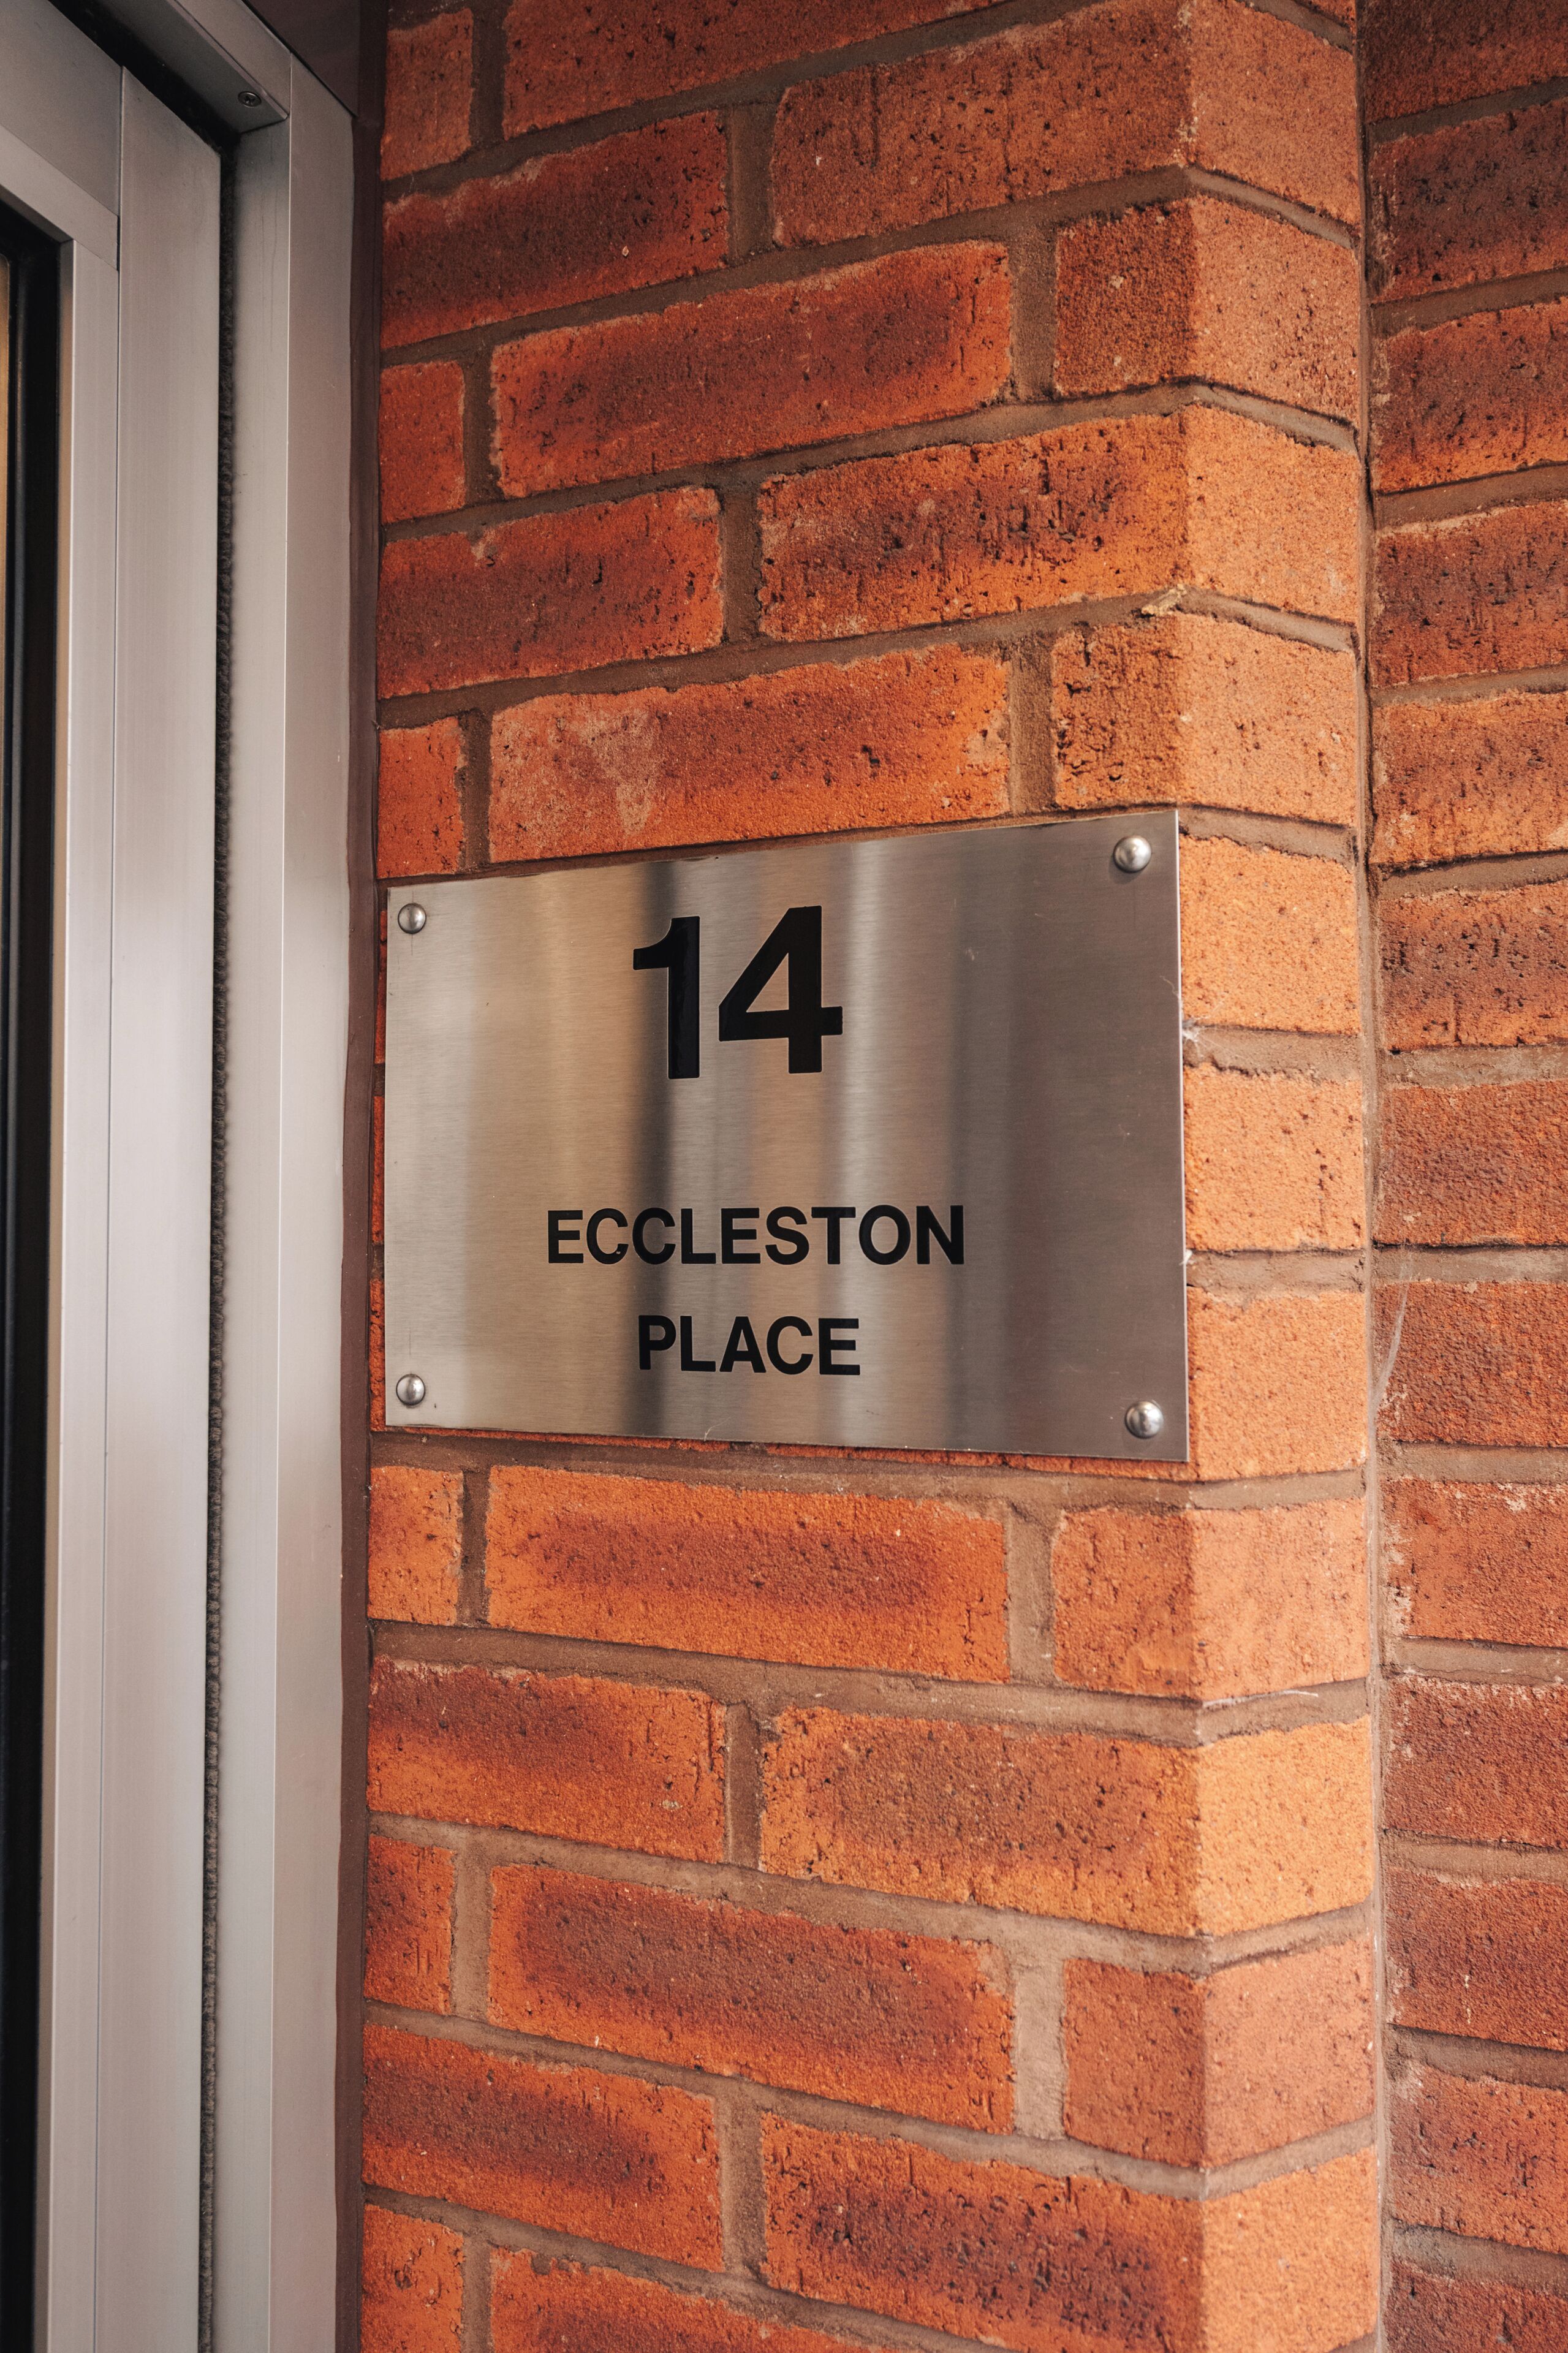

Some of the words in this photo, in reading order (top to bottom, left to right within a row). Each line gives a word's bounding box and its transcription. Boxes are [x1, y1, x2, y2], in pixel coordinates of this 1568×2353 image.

[632, 905, 844, 1080] 14
[548, 1205, 965, 1265] ECCLESTON
[638, 1314, 861, 1376] PLACE
